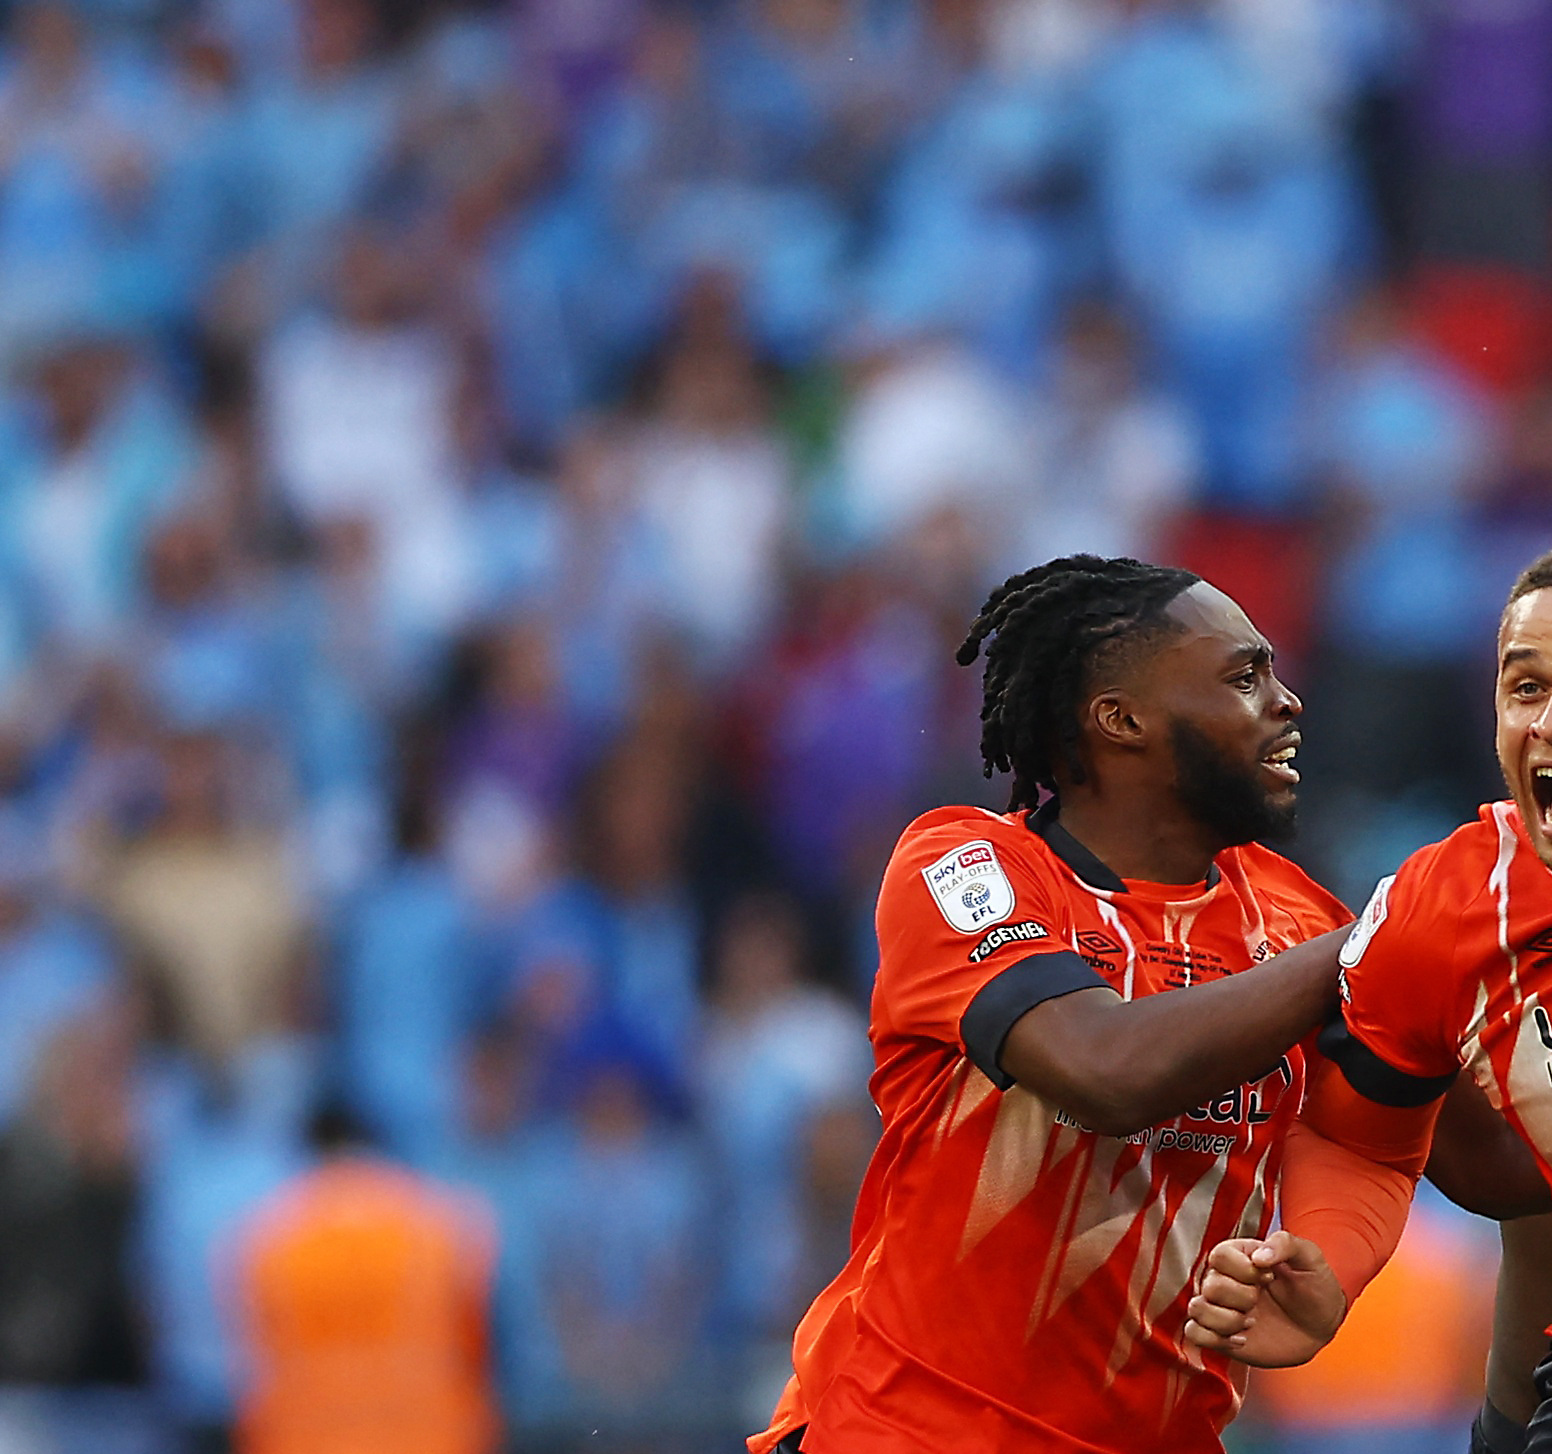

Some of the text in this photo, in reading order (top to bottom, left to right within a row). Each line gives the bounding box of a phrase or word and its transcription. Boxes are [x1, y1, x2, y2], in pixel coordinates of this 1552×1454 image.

[933, 849, 989, 882] sky bet
[939, 863, 998, 895] PLAY-OFFS
[971, 905, 996, 922] EFL
[1157, 1125, 1238, 1154] power
